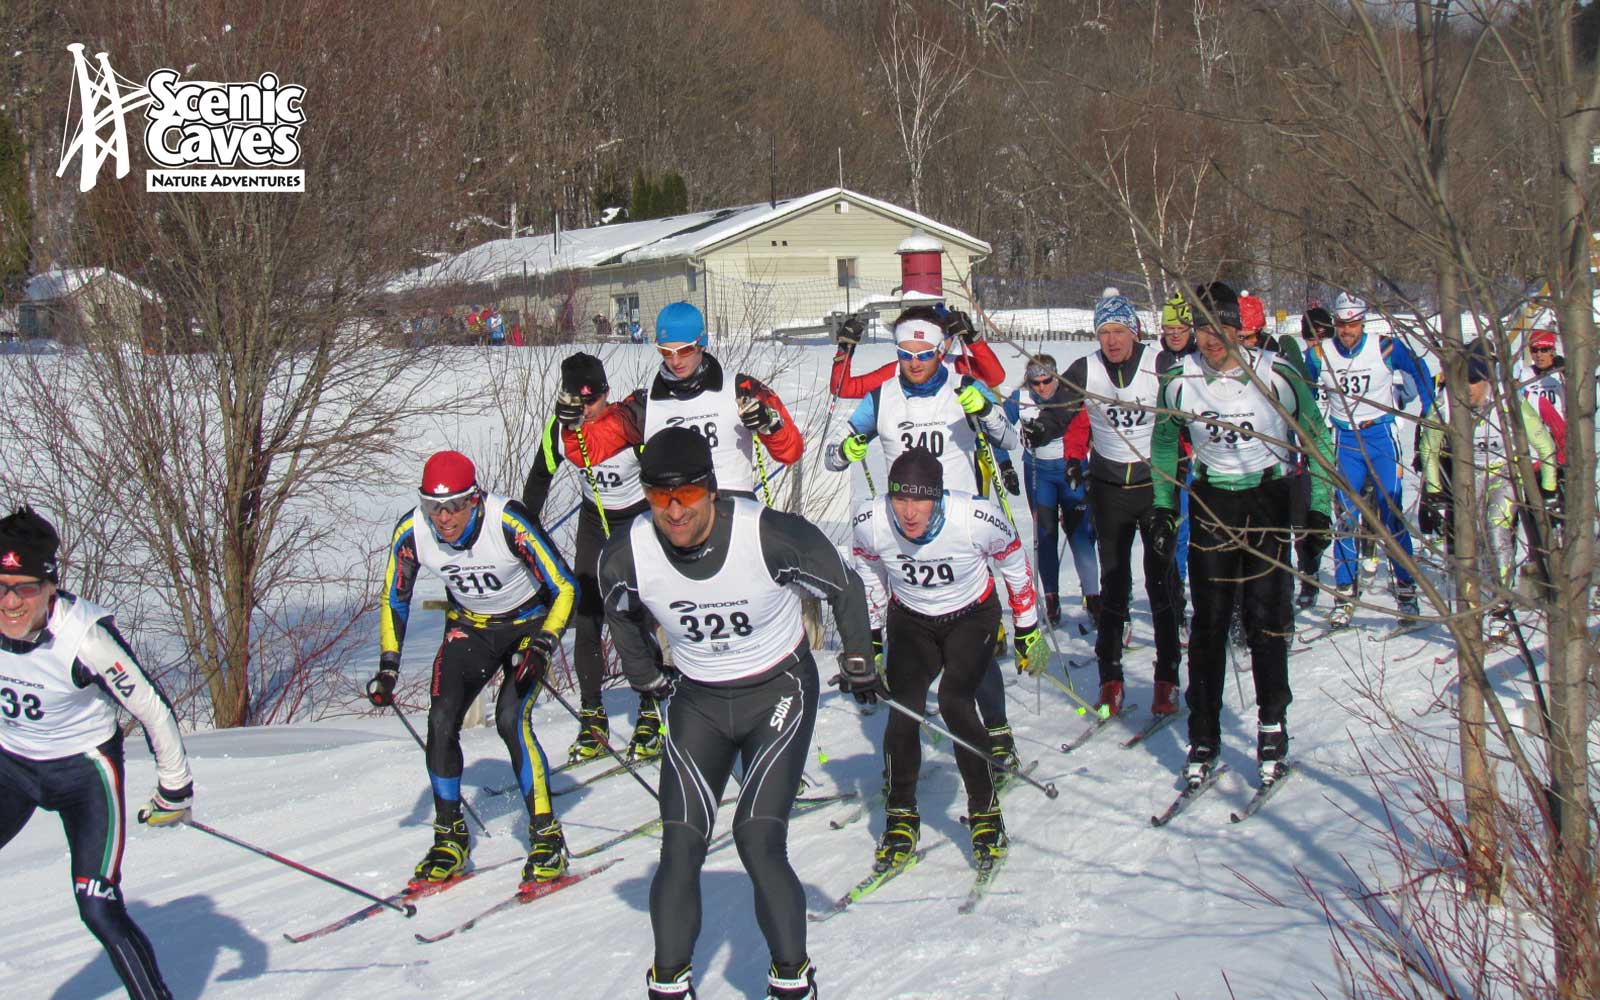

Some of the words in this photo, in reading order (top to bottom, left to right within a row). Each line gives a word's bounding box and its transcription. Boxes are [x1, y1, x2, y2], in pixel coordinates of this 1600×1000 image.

[1339, 375, 1371, 394] 337
[1106, 408, 1148, 428] 332
[900, 430, 944, 458] 340
[974, 509, 1012, 538] DIADORA
[901, 563, 955, 588] 329
[698, 599, 749, 609] BROOKS
[680, 611, 753, 643] 328
[104, 661, 137, 699] FILA
[75, 876, 118, 901] FILA
